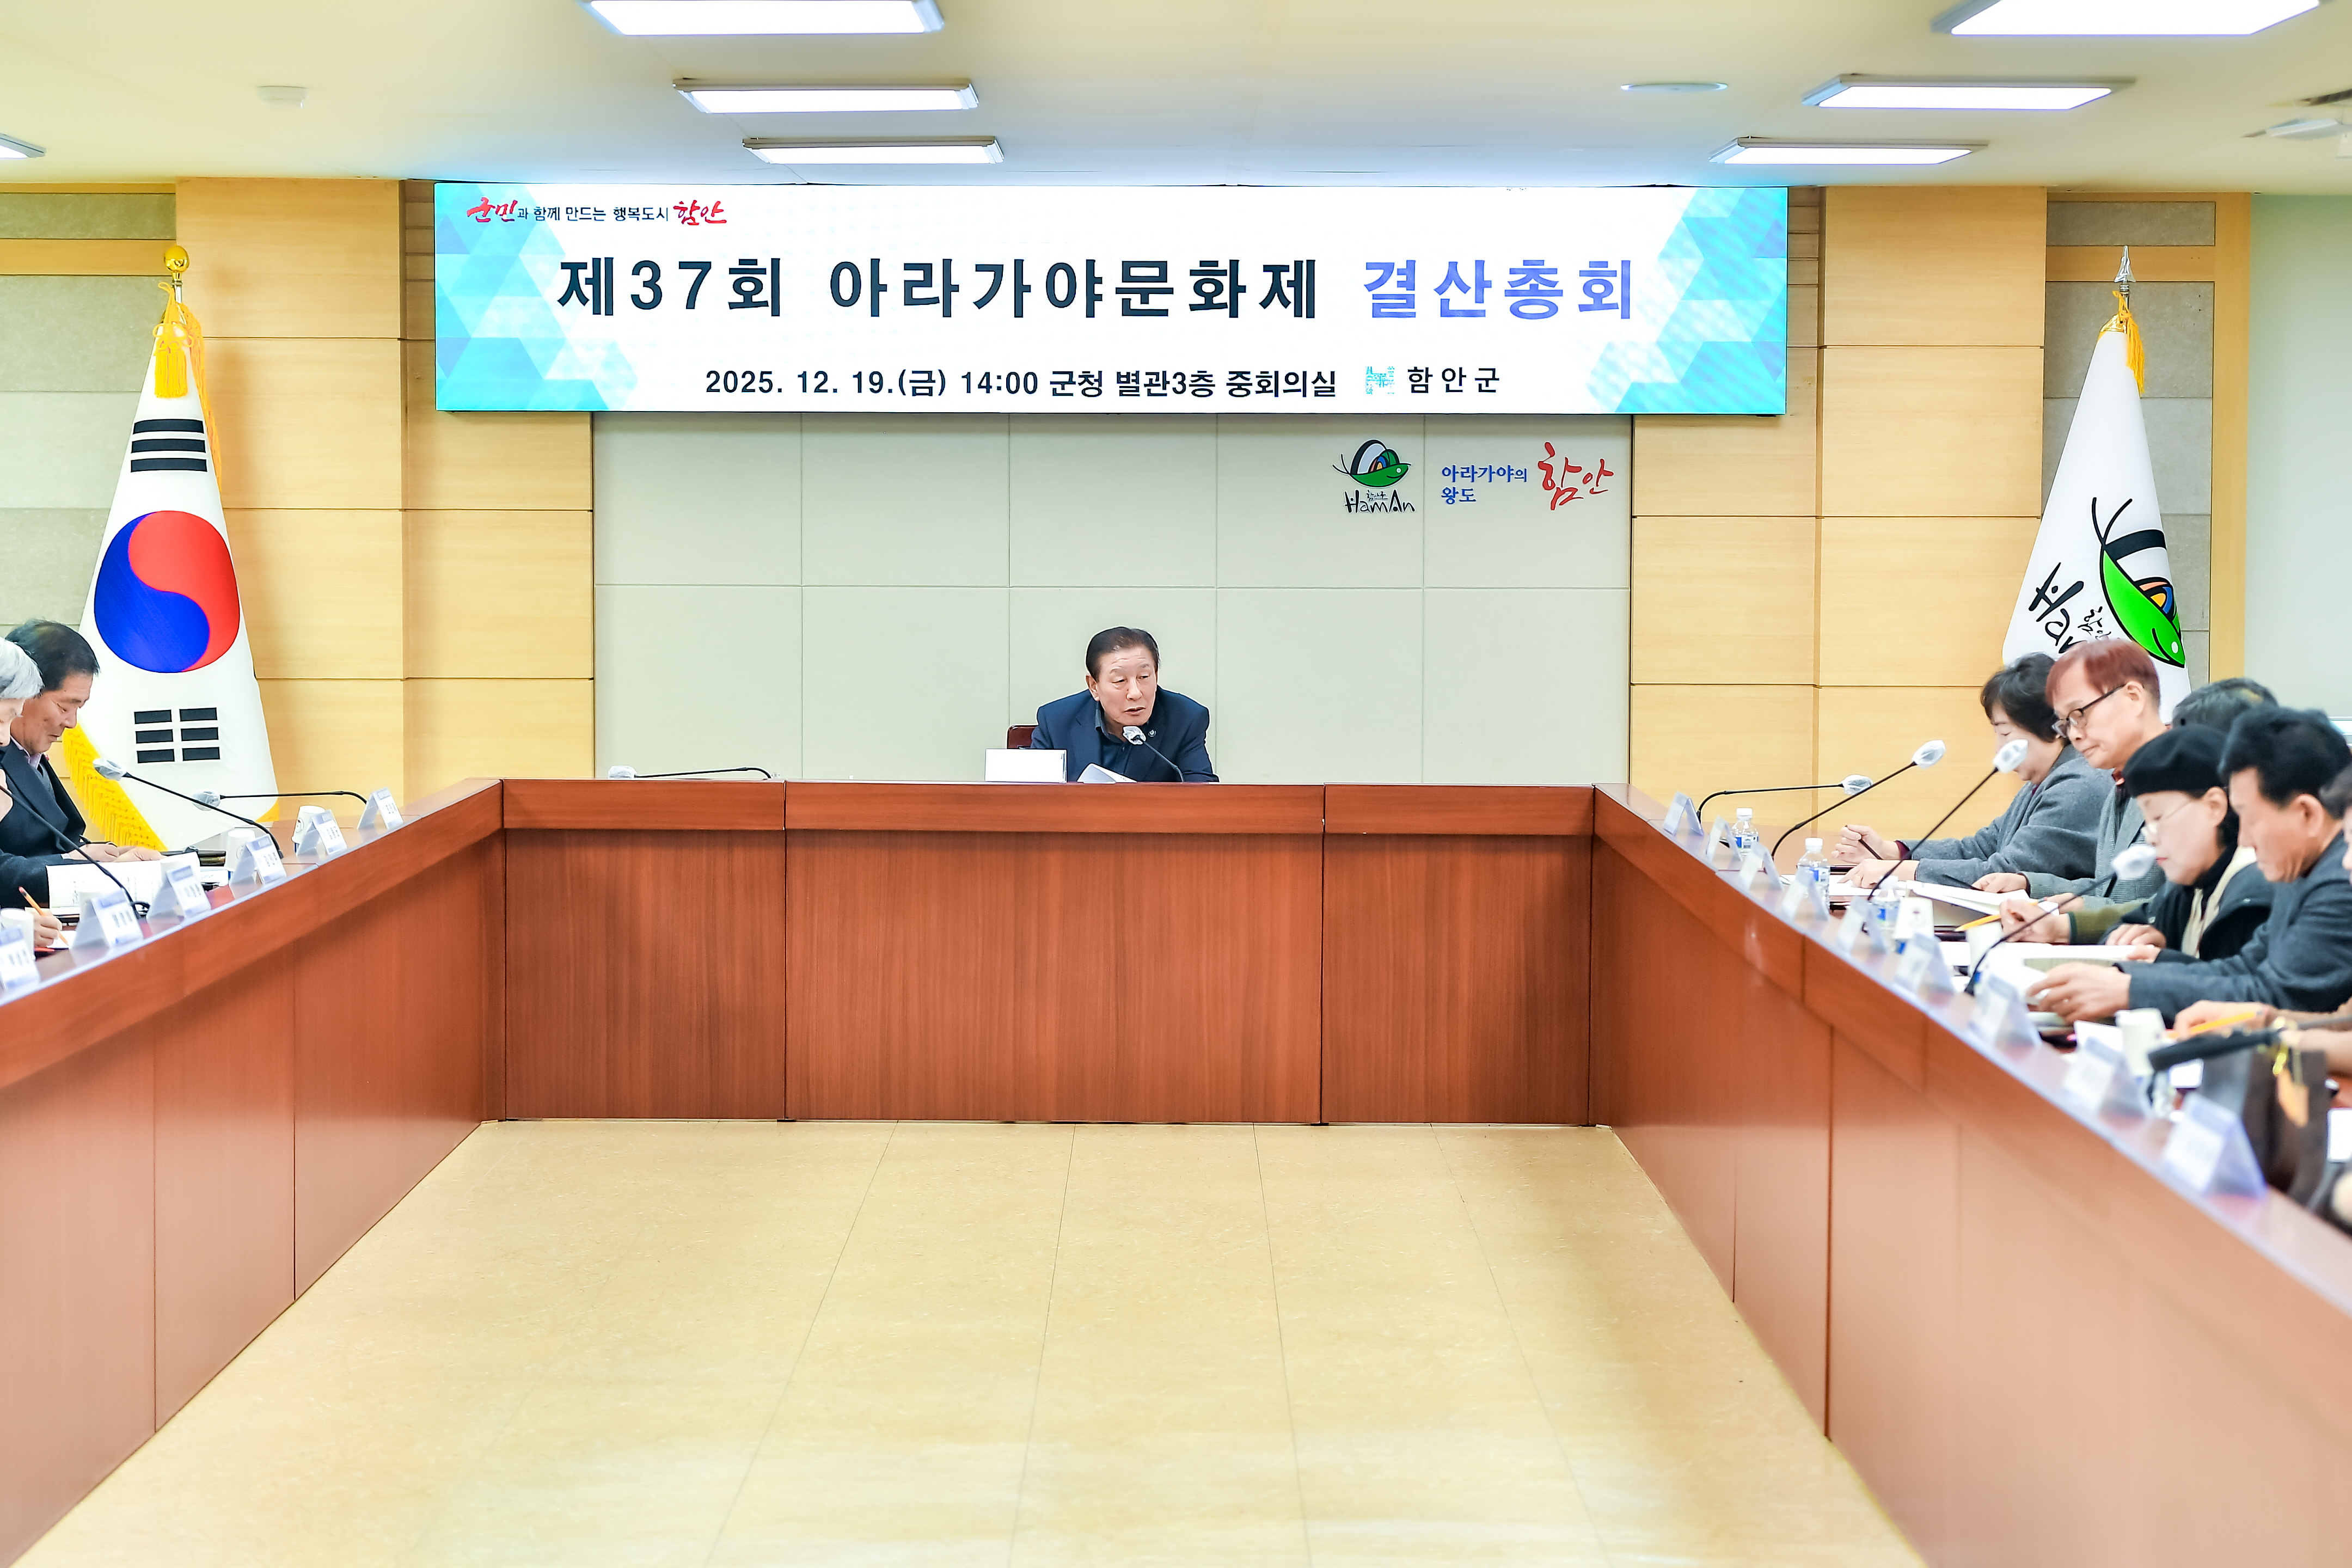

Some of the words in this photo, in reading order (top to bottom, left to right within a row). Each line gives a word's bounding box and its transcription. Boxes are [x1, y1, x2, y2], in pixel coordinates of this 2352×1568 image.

[467, 197, 529, 222] 군민과
[533, 206, 560, 221] 함께
[566, 206, 607, 222] 만드는
[613, 206, 669, 222] 행복도시
[673, 199, 727, 225] 함안
[557, 256, 781, 317] 제37회
[830, 258, 1316, 319] 아라가야문화제
[1364, 259, 1631, 320] 결산총회
[706, 370, 782, 394] 2025.
[797, 370, 838, 394] 12.
[852, 369, 946, 397] 19.(금)
[961, 371, 1038, 395] 14:00
[1049, 370, 1102, 398] 군청
[1116, 370, 1216, 398] 별관3층
[1226, 370, 1336, 398] 중회의실
[1407, 366, 1500, 394] 함안군
[1441, 465, 1527, 482] 아라가야의
[1538, 442, 1614, 511] 함안
[1344, 489, 1416, 513] HamAn
[1441, 487, 1477, 505] 왕도
